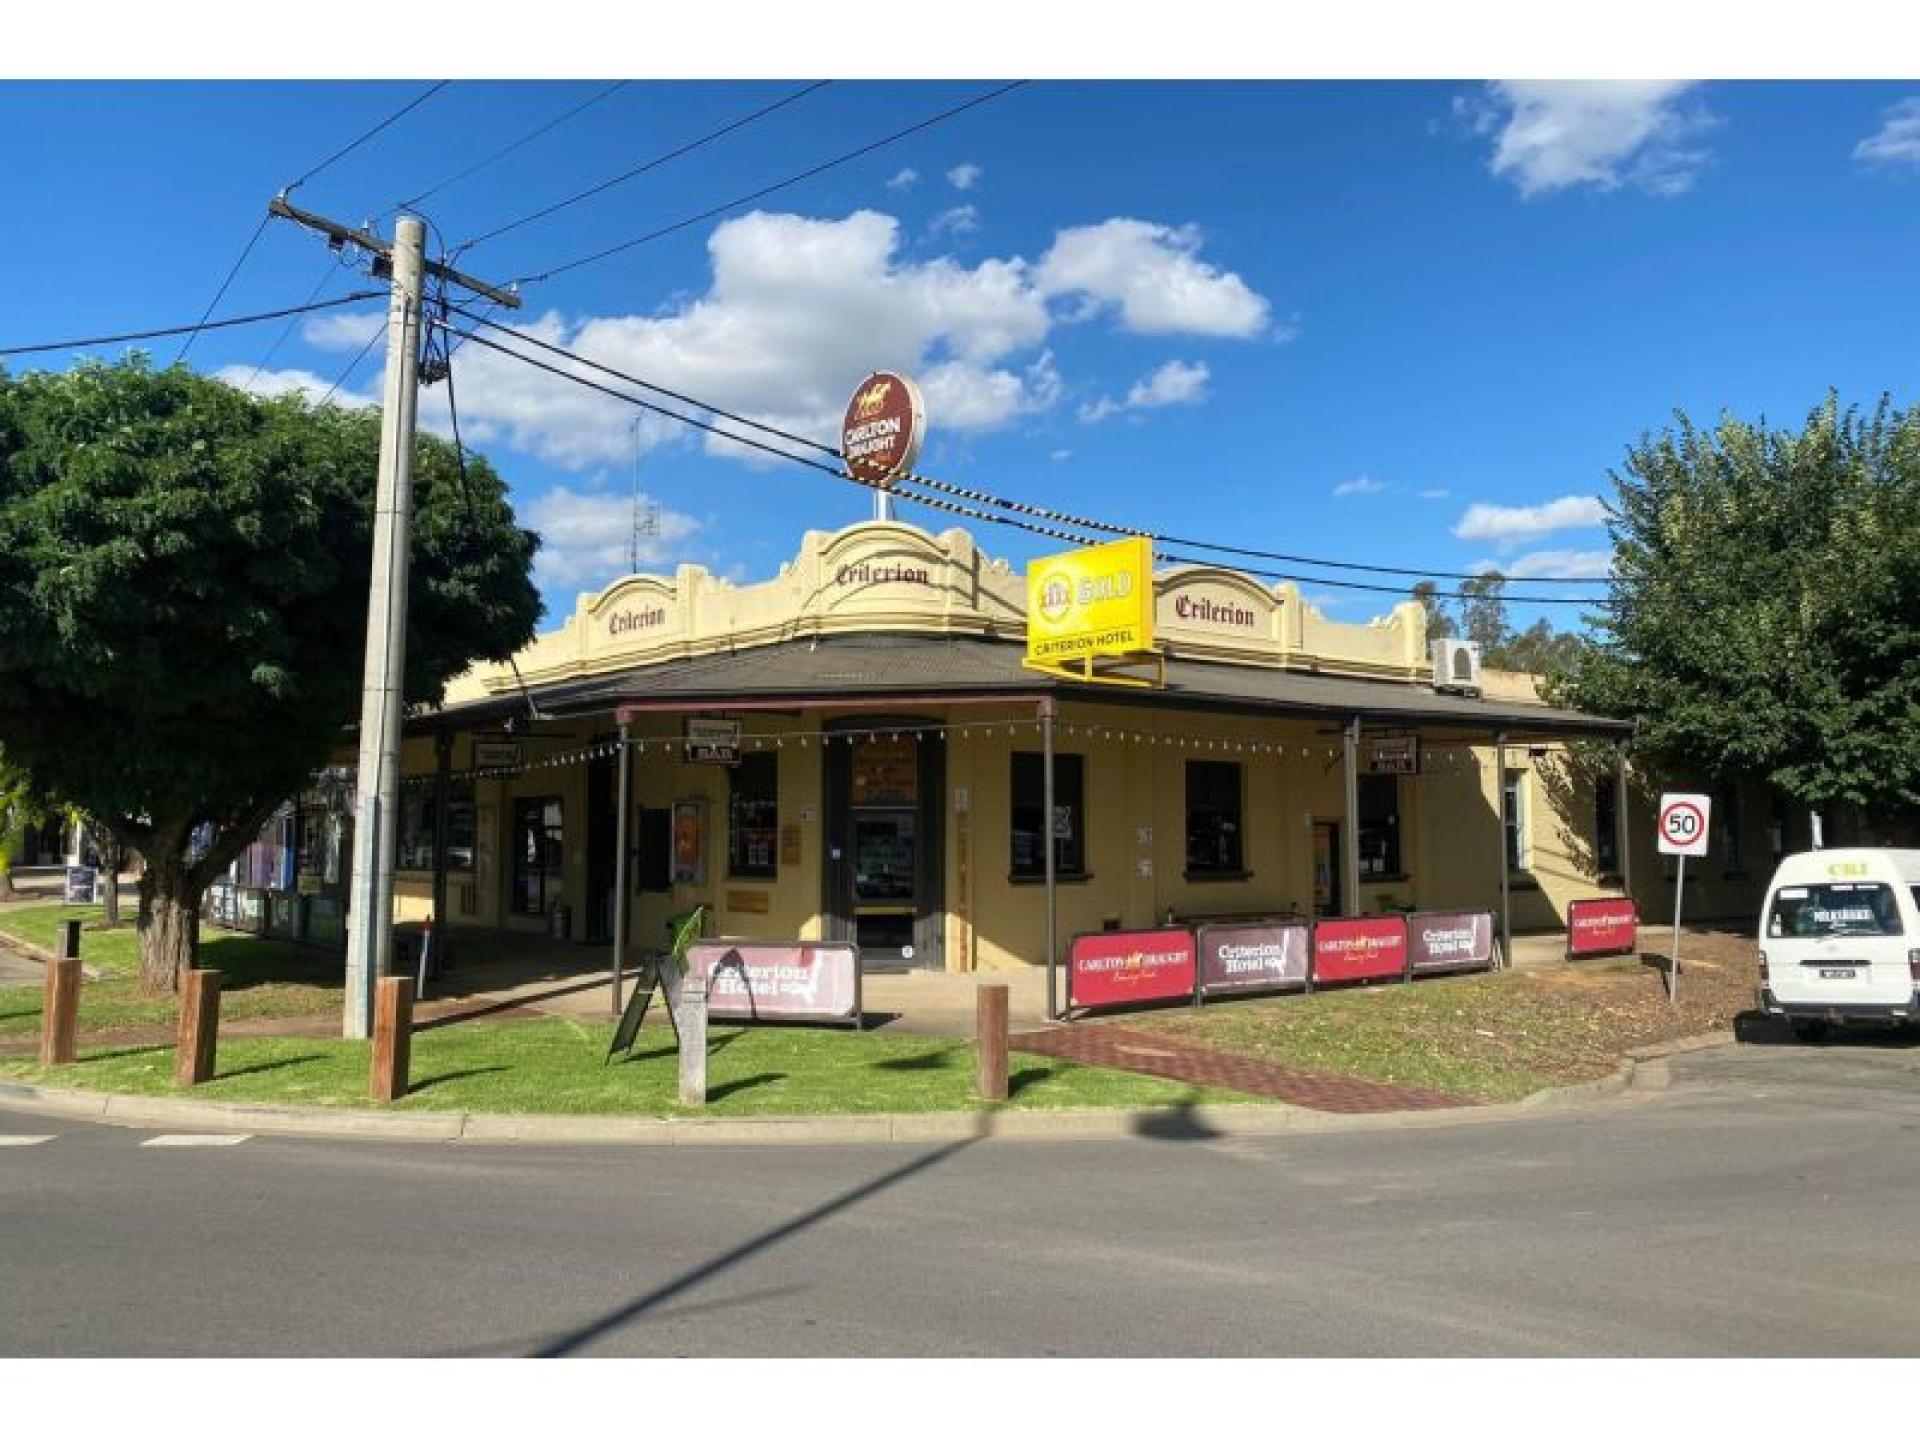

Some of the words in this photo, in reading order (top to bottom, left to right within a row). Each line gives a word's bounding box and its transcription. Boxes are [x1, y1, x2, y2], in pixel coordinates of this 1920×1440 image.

[835, 561, 927, 586] Criterion
[609, 604, 666, 635] Criterion
[1175, 595, 1254, 626] Criterion
[1034, 638, 1094, 656] CRITERION
[1095, 630, 1135, 646] HOTEL
[1669, 814, 1696, 834] 50
[1218, 943, 1281, 960] Criterion
[708, 959, 809, 979] Criterion
[1079, 957, 1123, 973] CARLTON
[1226, 957, 1264, 974] Hotel
[718, 977, 776, 996] Hotel
